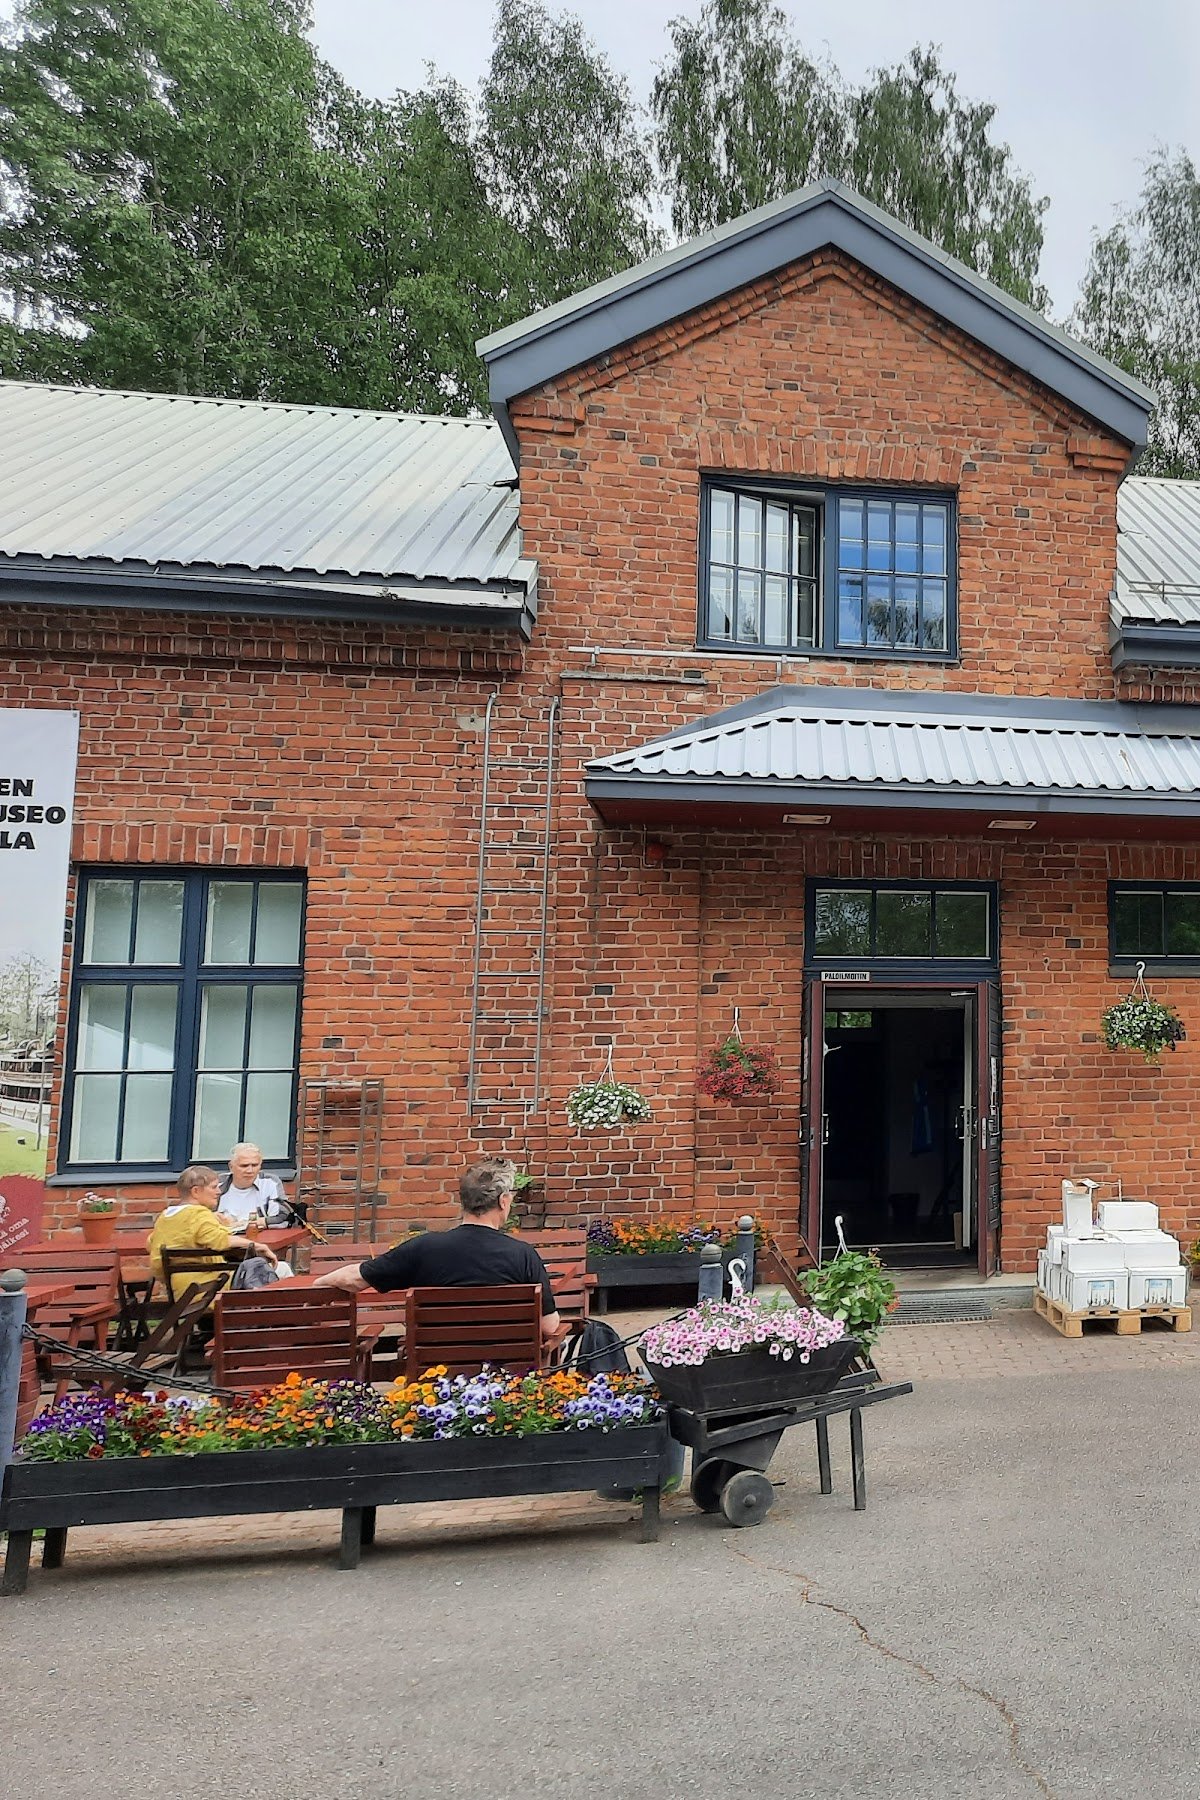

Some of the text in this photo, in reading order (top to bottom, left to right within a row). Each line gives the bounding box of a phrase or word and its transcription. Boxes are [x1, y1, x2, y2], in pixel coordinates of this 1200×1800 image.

[0, 779, 34, 797] EN
[0, 831, 36, 850] LA
[9, 1218, 30, 1233] oma
